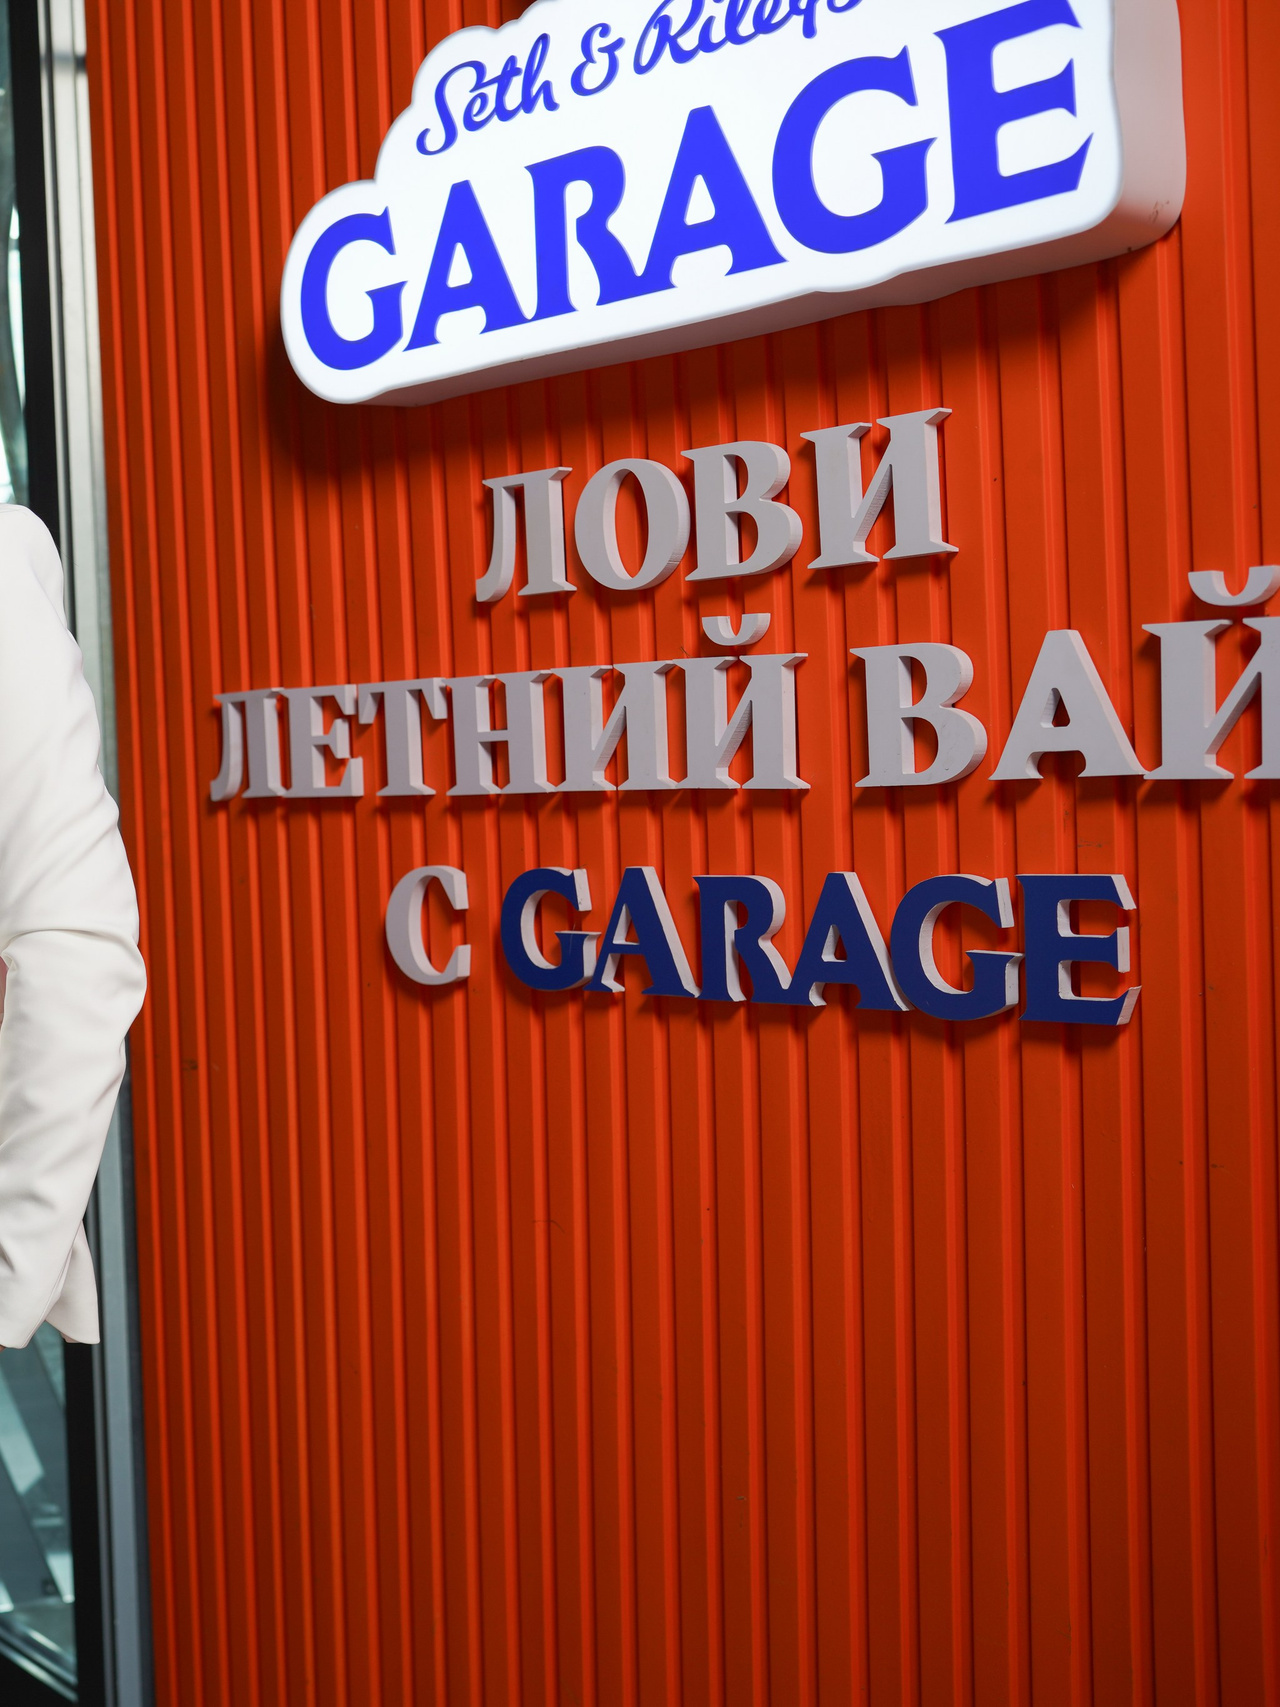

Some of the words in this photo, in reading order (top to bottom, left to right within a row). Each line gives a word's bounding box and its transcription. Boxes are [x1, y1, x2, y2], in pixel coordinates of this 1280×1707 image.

[416, 33, 560, 156] Seth
[570, 22, 626, 97] &
[300, 0, 1093, 372] GARAGE
[476, 407, 959, 603] ЛОВИ
[210, 613, 811, 801] ЛЕТНИЙ
[385, 865, 471, 986] С
[502, 866, 1141, 1027] GARAGE
